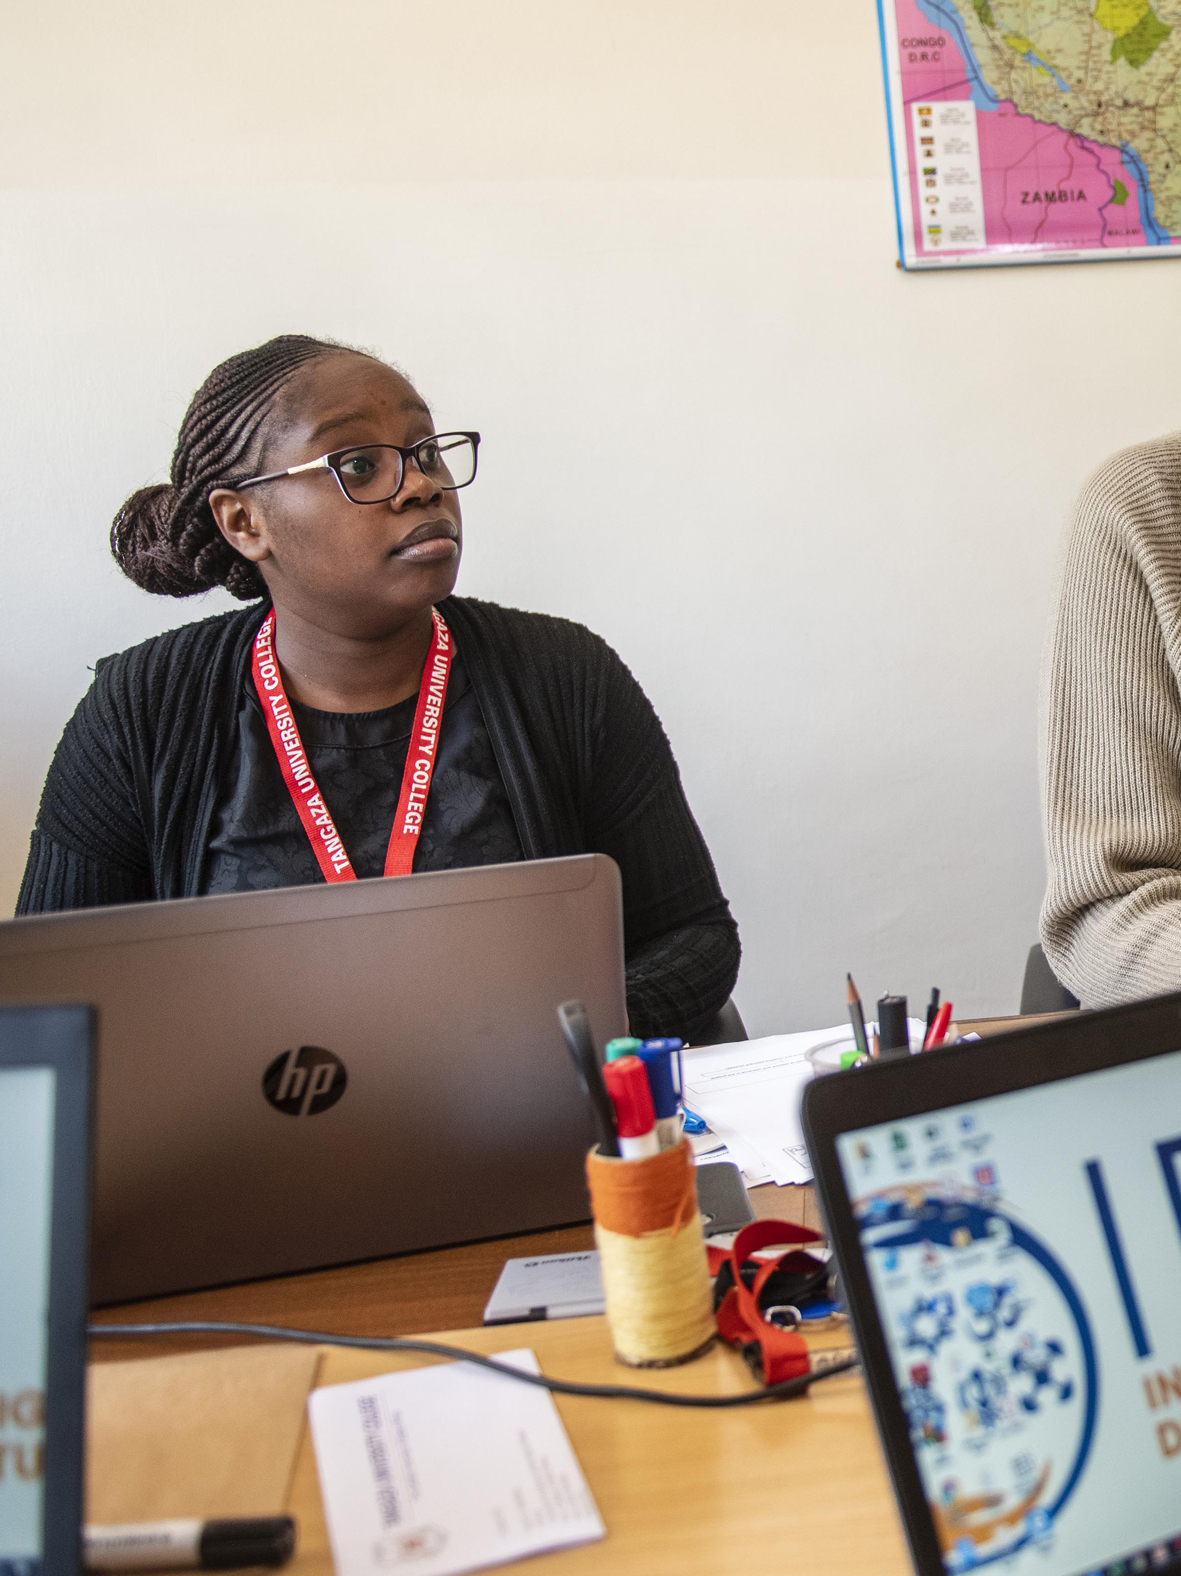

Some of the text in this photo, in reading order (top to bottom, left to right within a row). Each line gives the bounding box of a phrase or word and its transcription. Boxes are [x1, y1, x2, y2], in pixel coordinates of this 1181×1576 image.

[902, 37, 946, 48] CONGO
[1020, 190, 1088, 204] ZAMBIA
[418, 655, 449, 756] UNIVERSITY
[256, 616, 351, 874] TANGAZA UNIVERSITY COLLEGE
[402, 759, 431, 835] COLLEGE
[276, 1046, 337, 1116] hp
